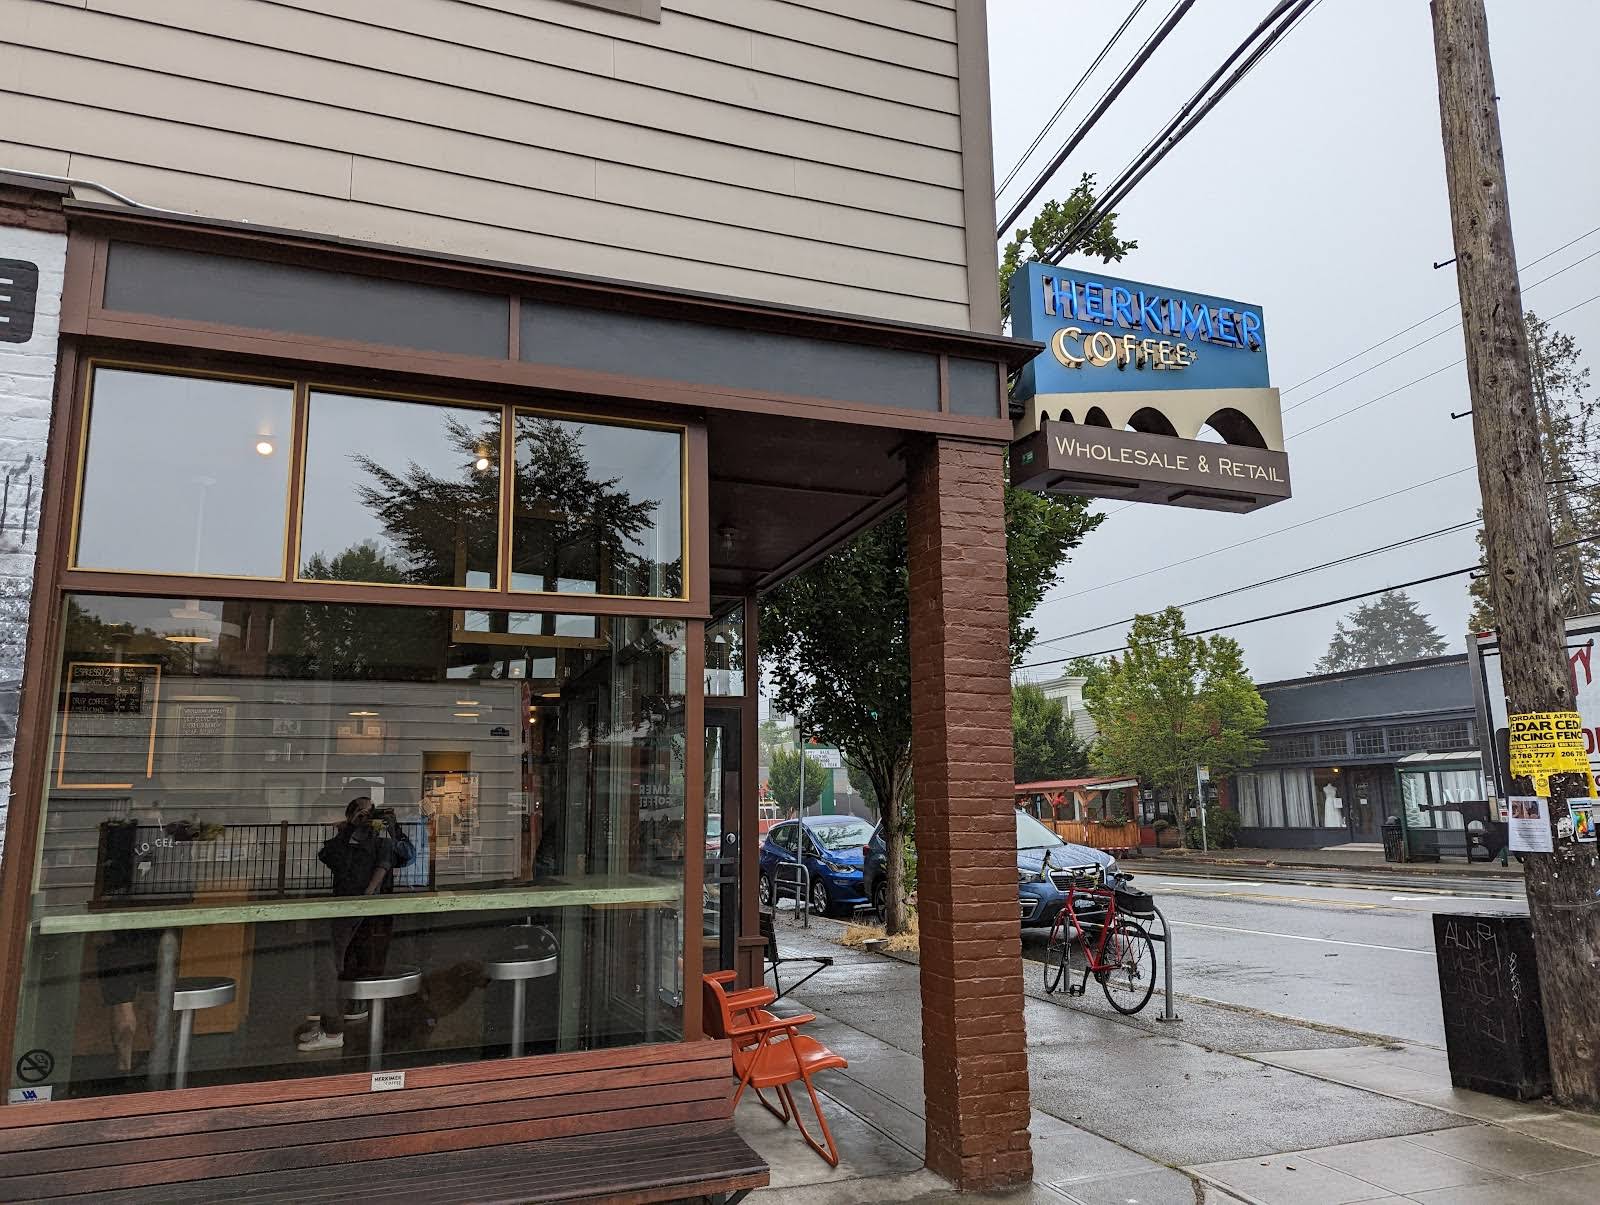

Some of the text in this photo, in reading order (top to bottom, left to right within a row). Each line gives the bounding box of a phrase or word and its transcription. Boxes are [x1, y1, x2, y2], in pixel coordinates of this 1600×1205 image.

[1042, 275, 1262, 352] HERKIMER
[1052, 326, 1192, 370] COFFEE
[1198, 455, 1210, 473] &
[1555, 719, 1582, 730] CED
[1535, 751, 1555, 759] 7777
